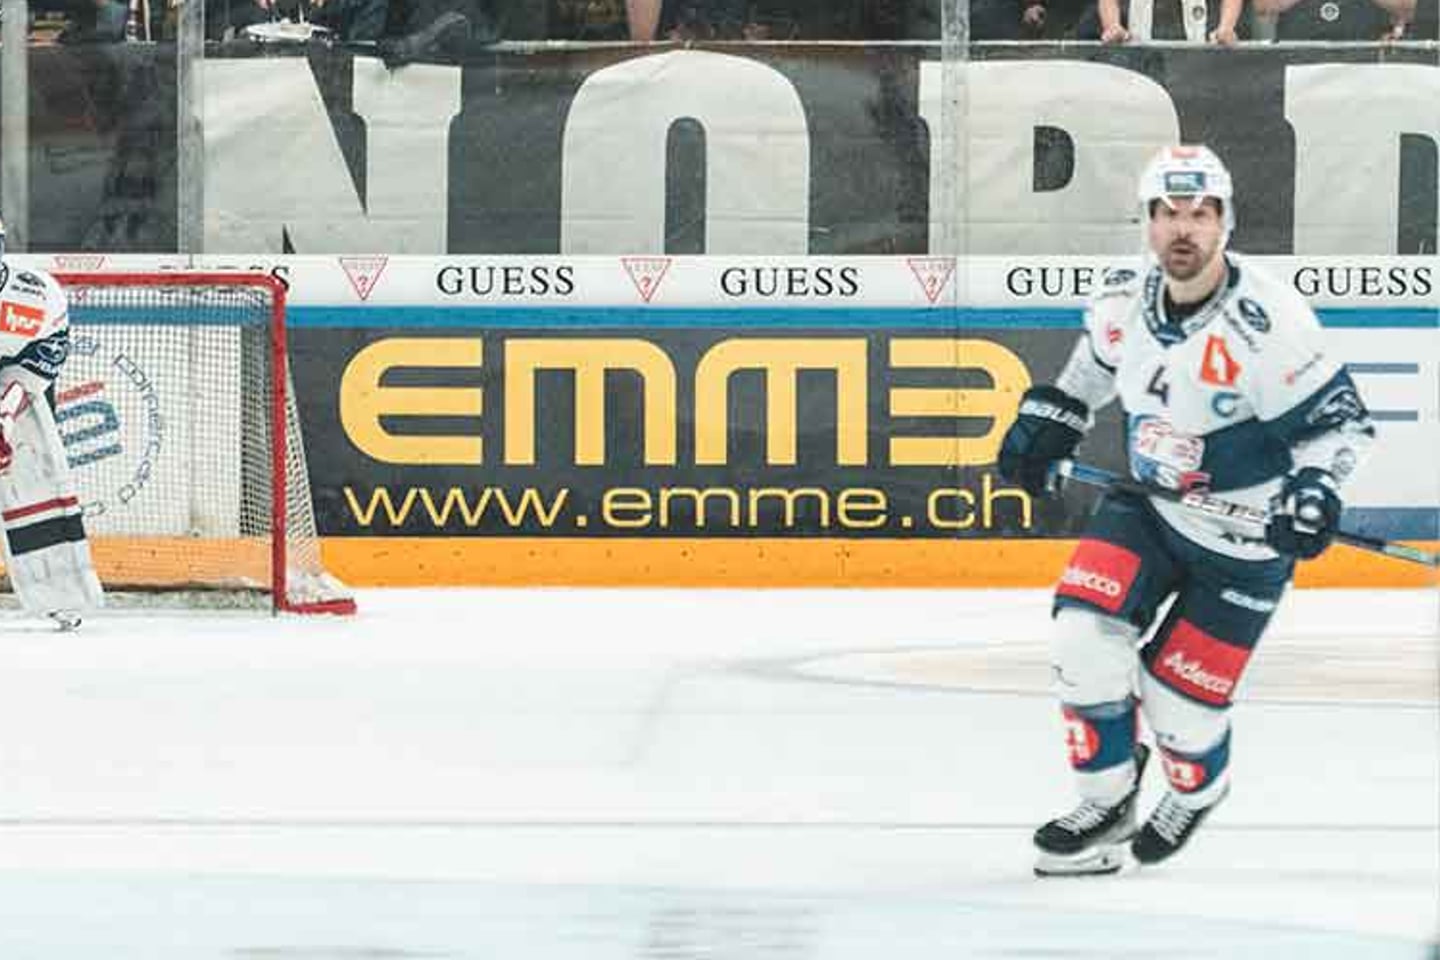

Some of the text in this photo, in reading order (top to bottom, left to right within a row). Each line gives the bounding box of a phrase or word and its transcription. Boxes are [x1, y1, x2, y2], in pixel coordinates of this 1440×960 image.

[437, 266, 574, 295] GUESS
[720, 266, 858, 295] GUESS
[1293, 266, 1431, 295] GUESS
[1146, 365, 1170, 407] 4
[344, 474, 1031, 528] www.emme.ch
